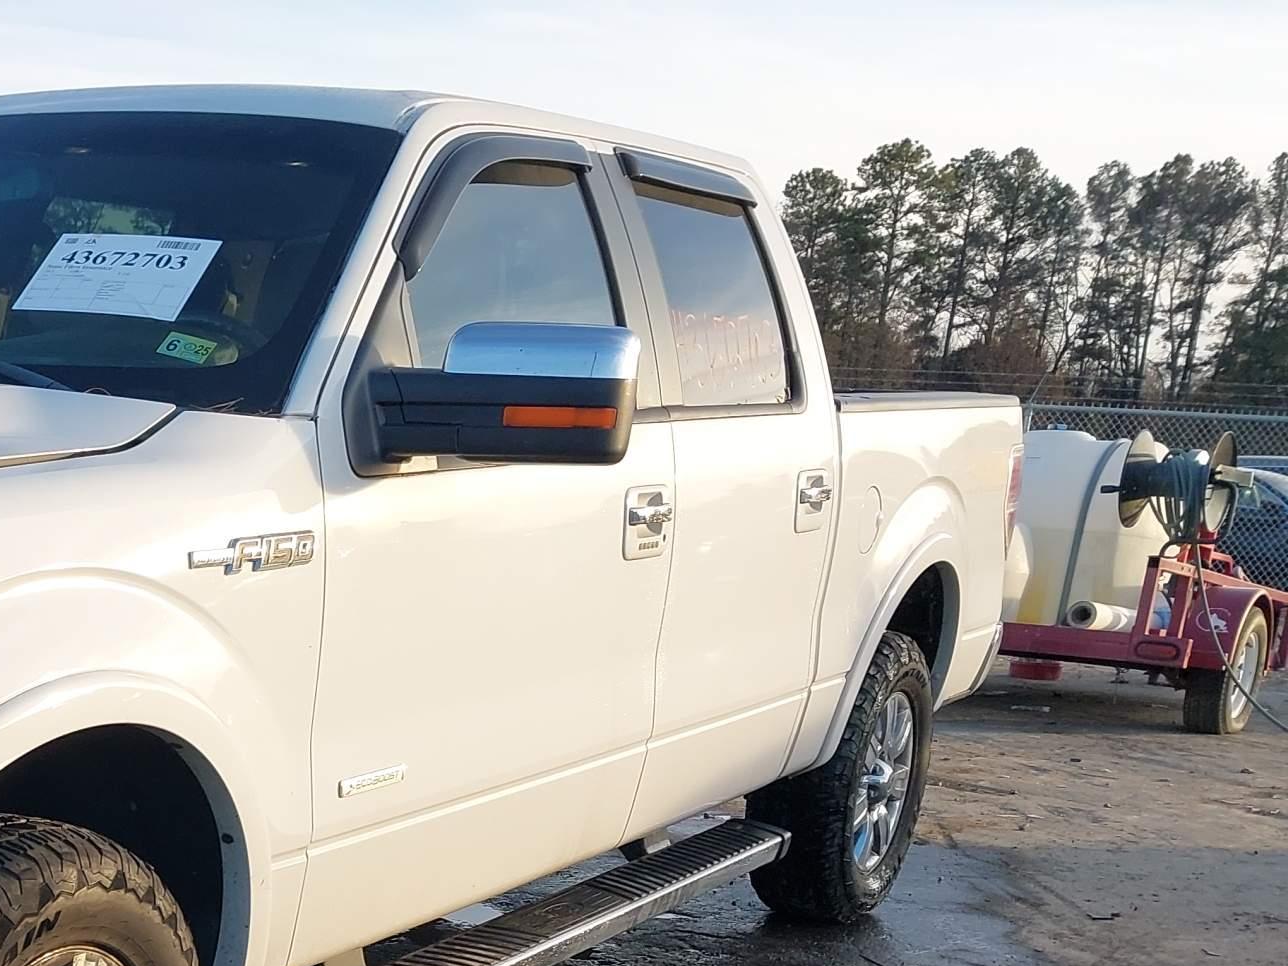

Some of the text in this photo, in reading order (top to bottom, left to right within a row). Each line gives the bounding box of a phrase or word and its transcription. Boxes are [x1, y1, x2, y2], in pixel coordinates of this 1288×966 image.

[62, 250, 189, 271] 43672703
[166, 340, 212, 357] 6 25
